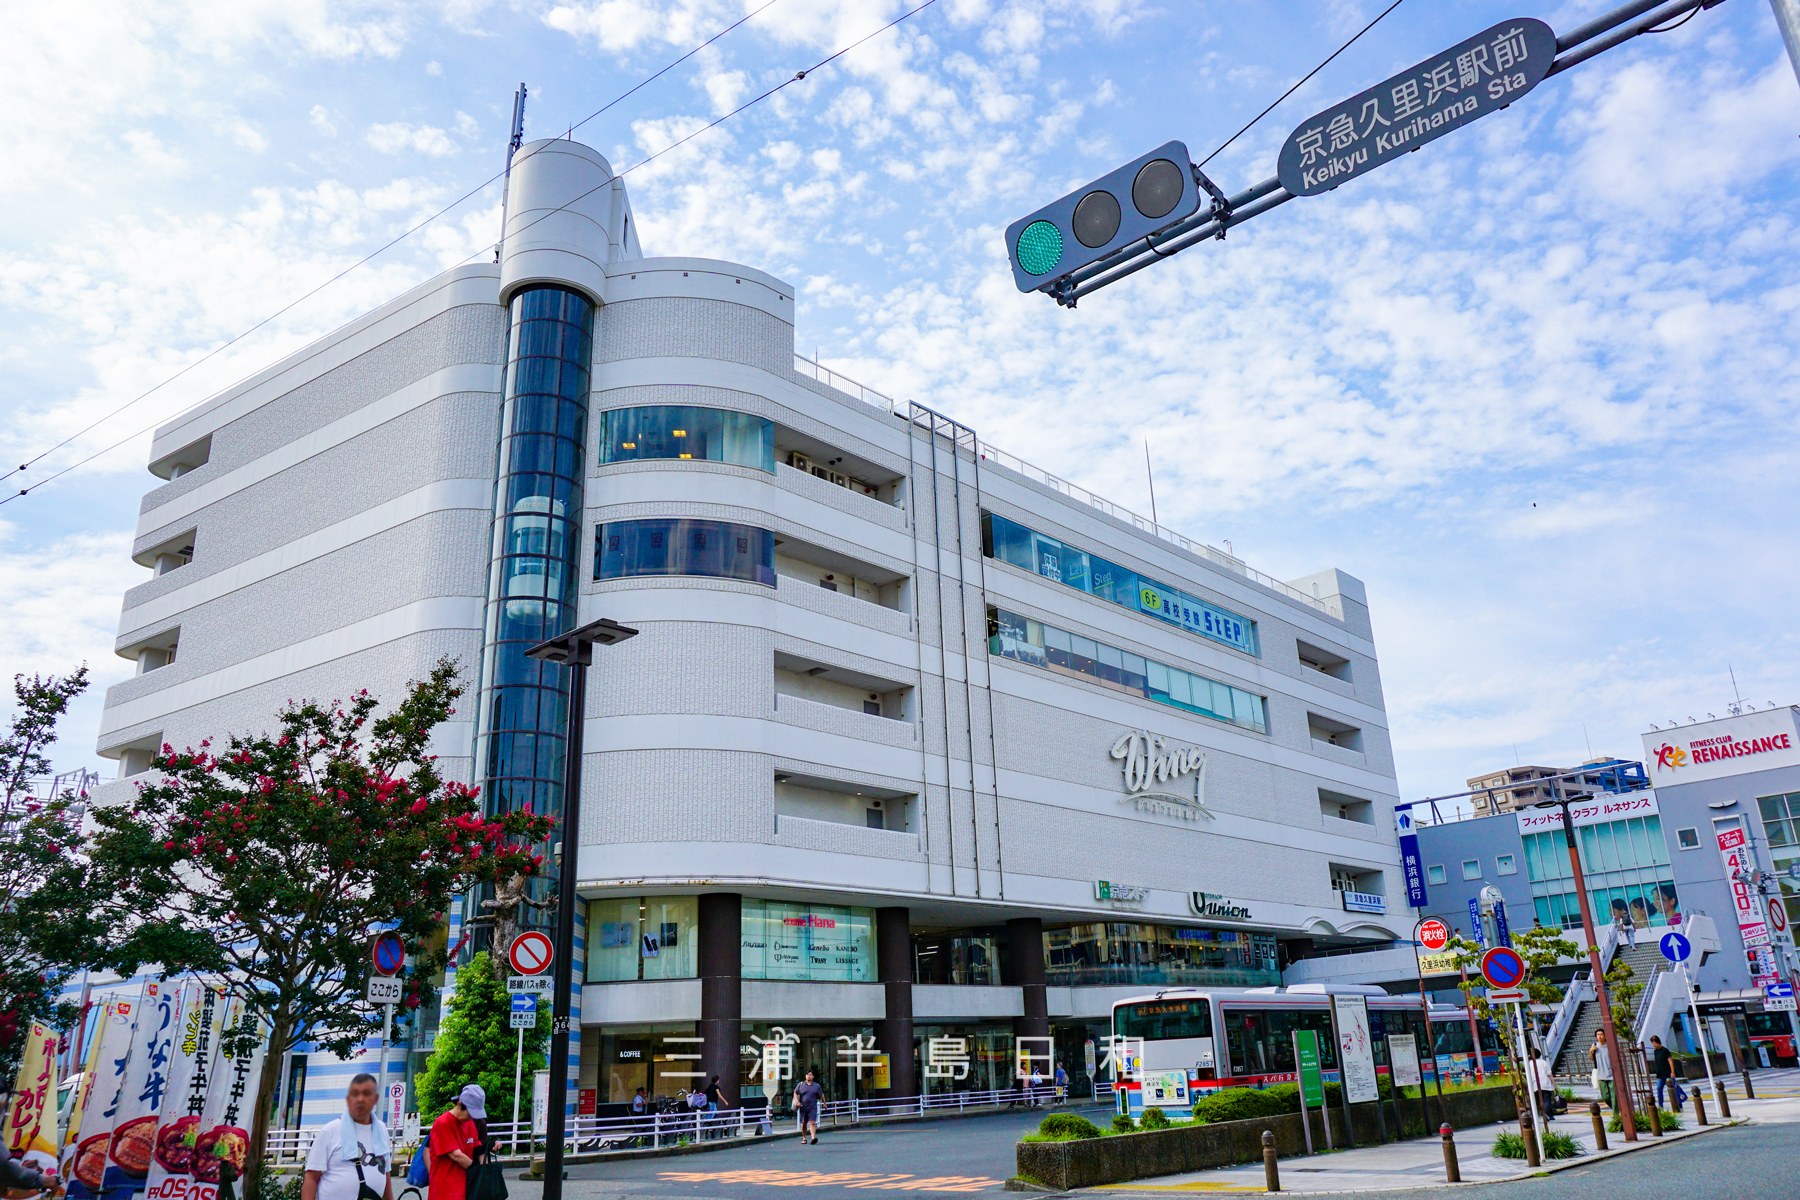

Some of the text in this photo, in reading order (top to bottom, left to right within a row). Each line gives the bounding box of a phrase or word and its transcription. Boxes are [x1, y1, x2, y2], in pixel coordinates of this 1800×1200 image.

[1296, 27, 1530, 169] 京急久里浜駅前
[1302, 72, 1527, 190] Keikyu Kurihama Sta
[1163, 599, 1201, 627] 高校受験
[1690, 735, 1733, 749] FITNESS CLUB
[1691, 733, 1791, 764] RENAISSANCE
[1111, 729, 1207, 805] Wing
[1522, 798, 1651, 827] フィットネクラブ ルネサンス
[1719, 831, 1741, 842] スタート
[1405, 855, 1422, 900] 横浜銀行
[783, 914, 836, 929] cosme Hana
[1422, 928, 1446, 942] 消火栓
[808, 943, 830, 952] Kanebo
[836, 945, 858, 953] KANEBO
[810, 955, 827, 965] TWANY
[835, 957, 859, 965] LISSAGE
[370, 983, 399, 998] ここから
[509, 979, 551, 990] 路線バスを除く
[138, 993, 173, 1111] うな牛
[1195, 1060, 1214, 1068] F2857
[12, 1087, 35, 1148] カレー
